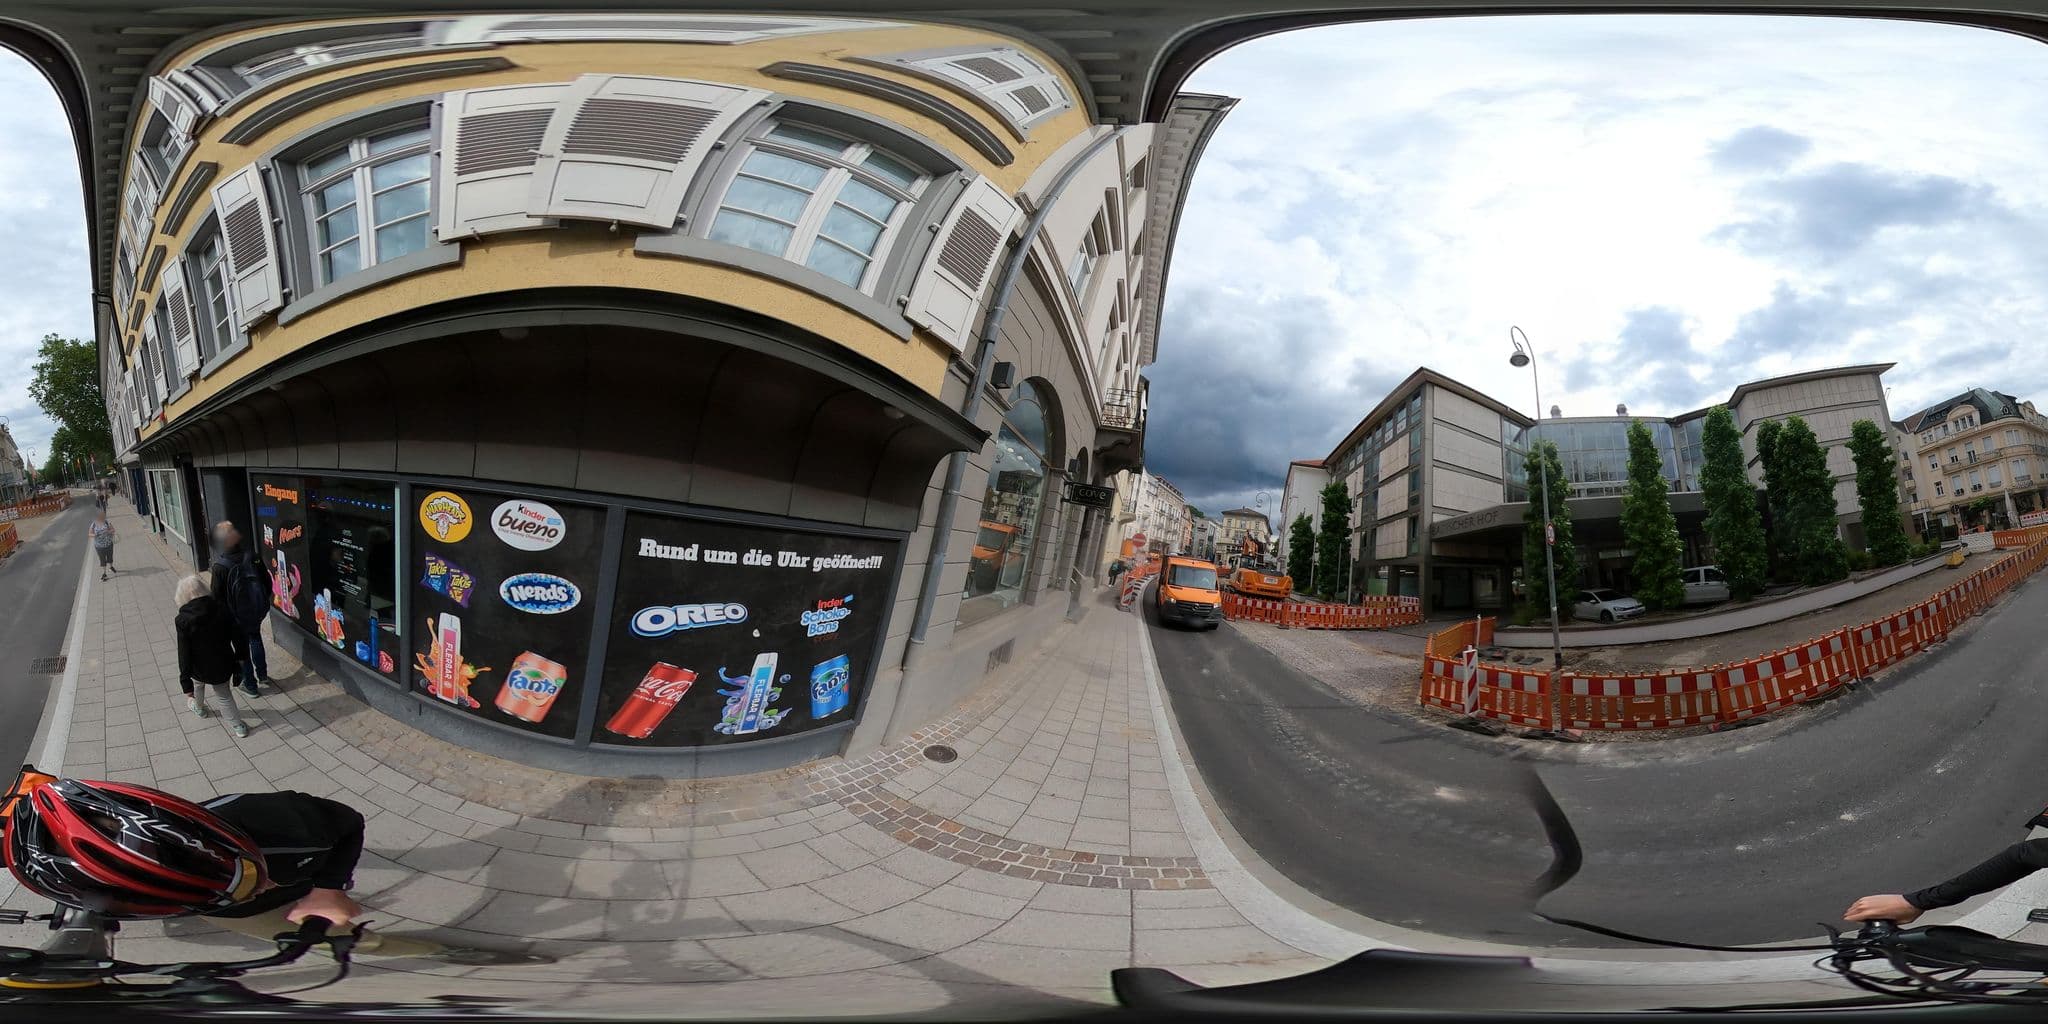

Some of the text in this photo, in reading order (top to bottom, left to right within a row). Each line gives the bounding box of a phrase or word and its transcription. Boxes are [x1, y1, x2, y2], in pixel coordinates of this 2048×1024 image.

[264, 484, 298, 504] Eingang
[498, 508, 559, 538] bueno
[279, 525, 302, 544] Mars
[639, 538, 883, 572] Rund um die Uhr geöffnet!!!
[428, 562, 448, 576] Takis
[451, 574, 473, 588] Takis
[635, 604, 747, 634] OREO
[807, 621, 840, 637] Bons
[508, 669, 558, 694] Fanta
[811, 671, 849, 700] Fanta
